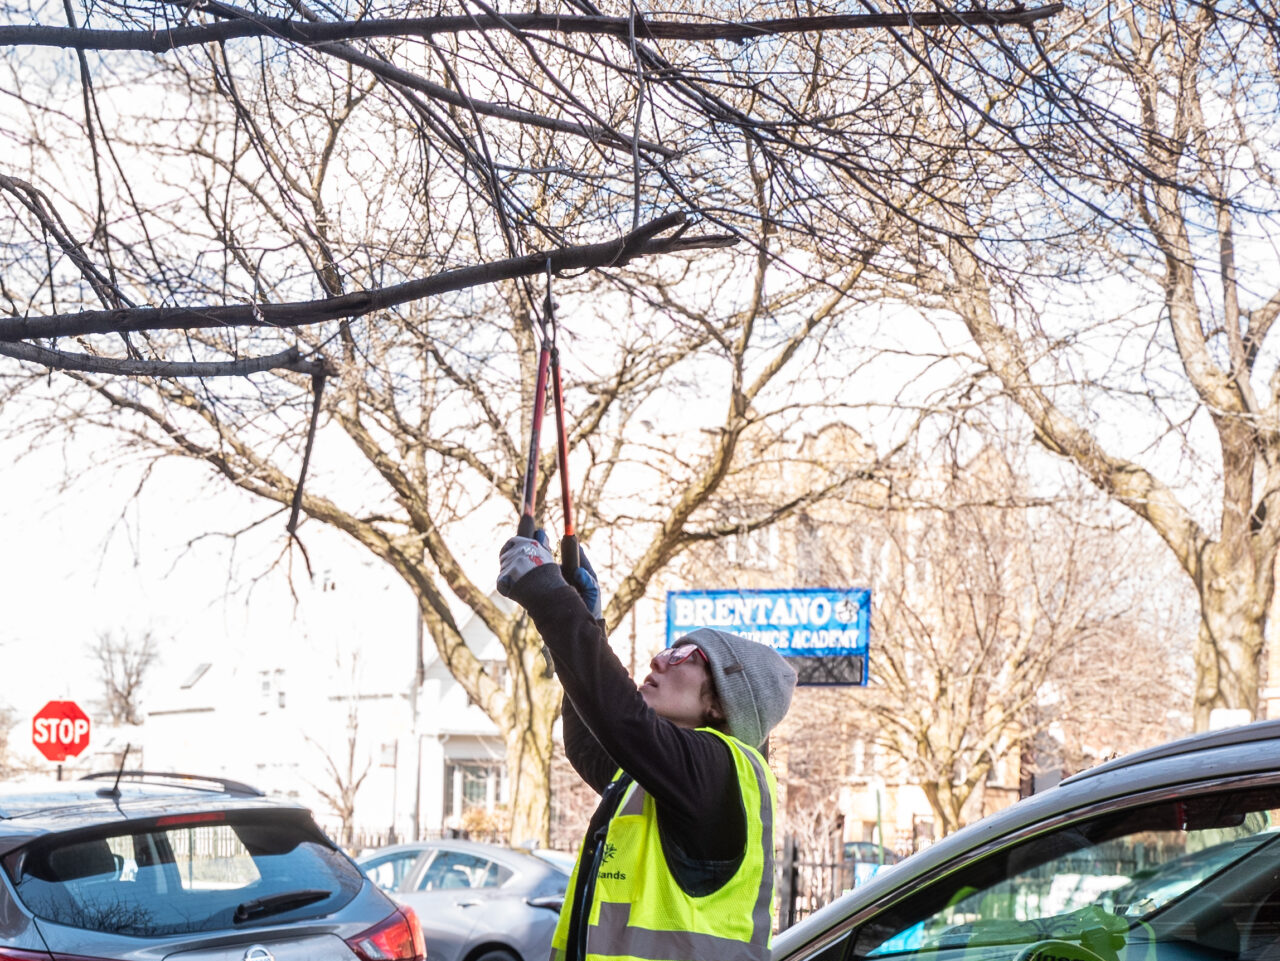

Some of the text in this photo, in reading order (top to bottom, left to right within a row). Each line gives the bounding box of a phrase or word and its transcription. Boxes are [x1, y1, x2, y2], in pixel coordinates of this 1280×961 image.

[675, 597, 831, 627] BRENTANO
[730, 629, 860, 649] IENCE ACADEMY
[34, 717, 89, 744] STOP
